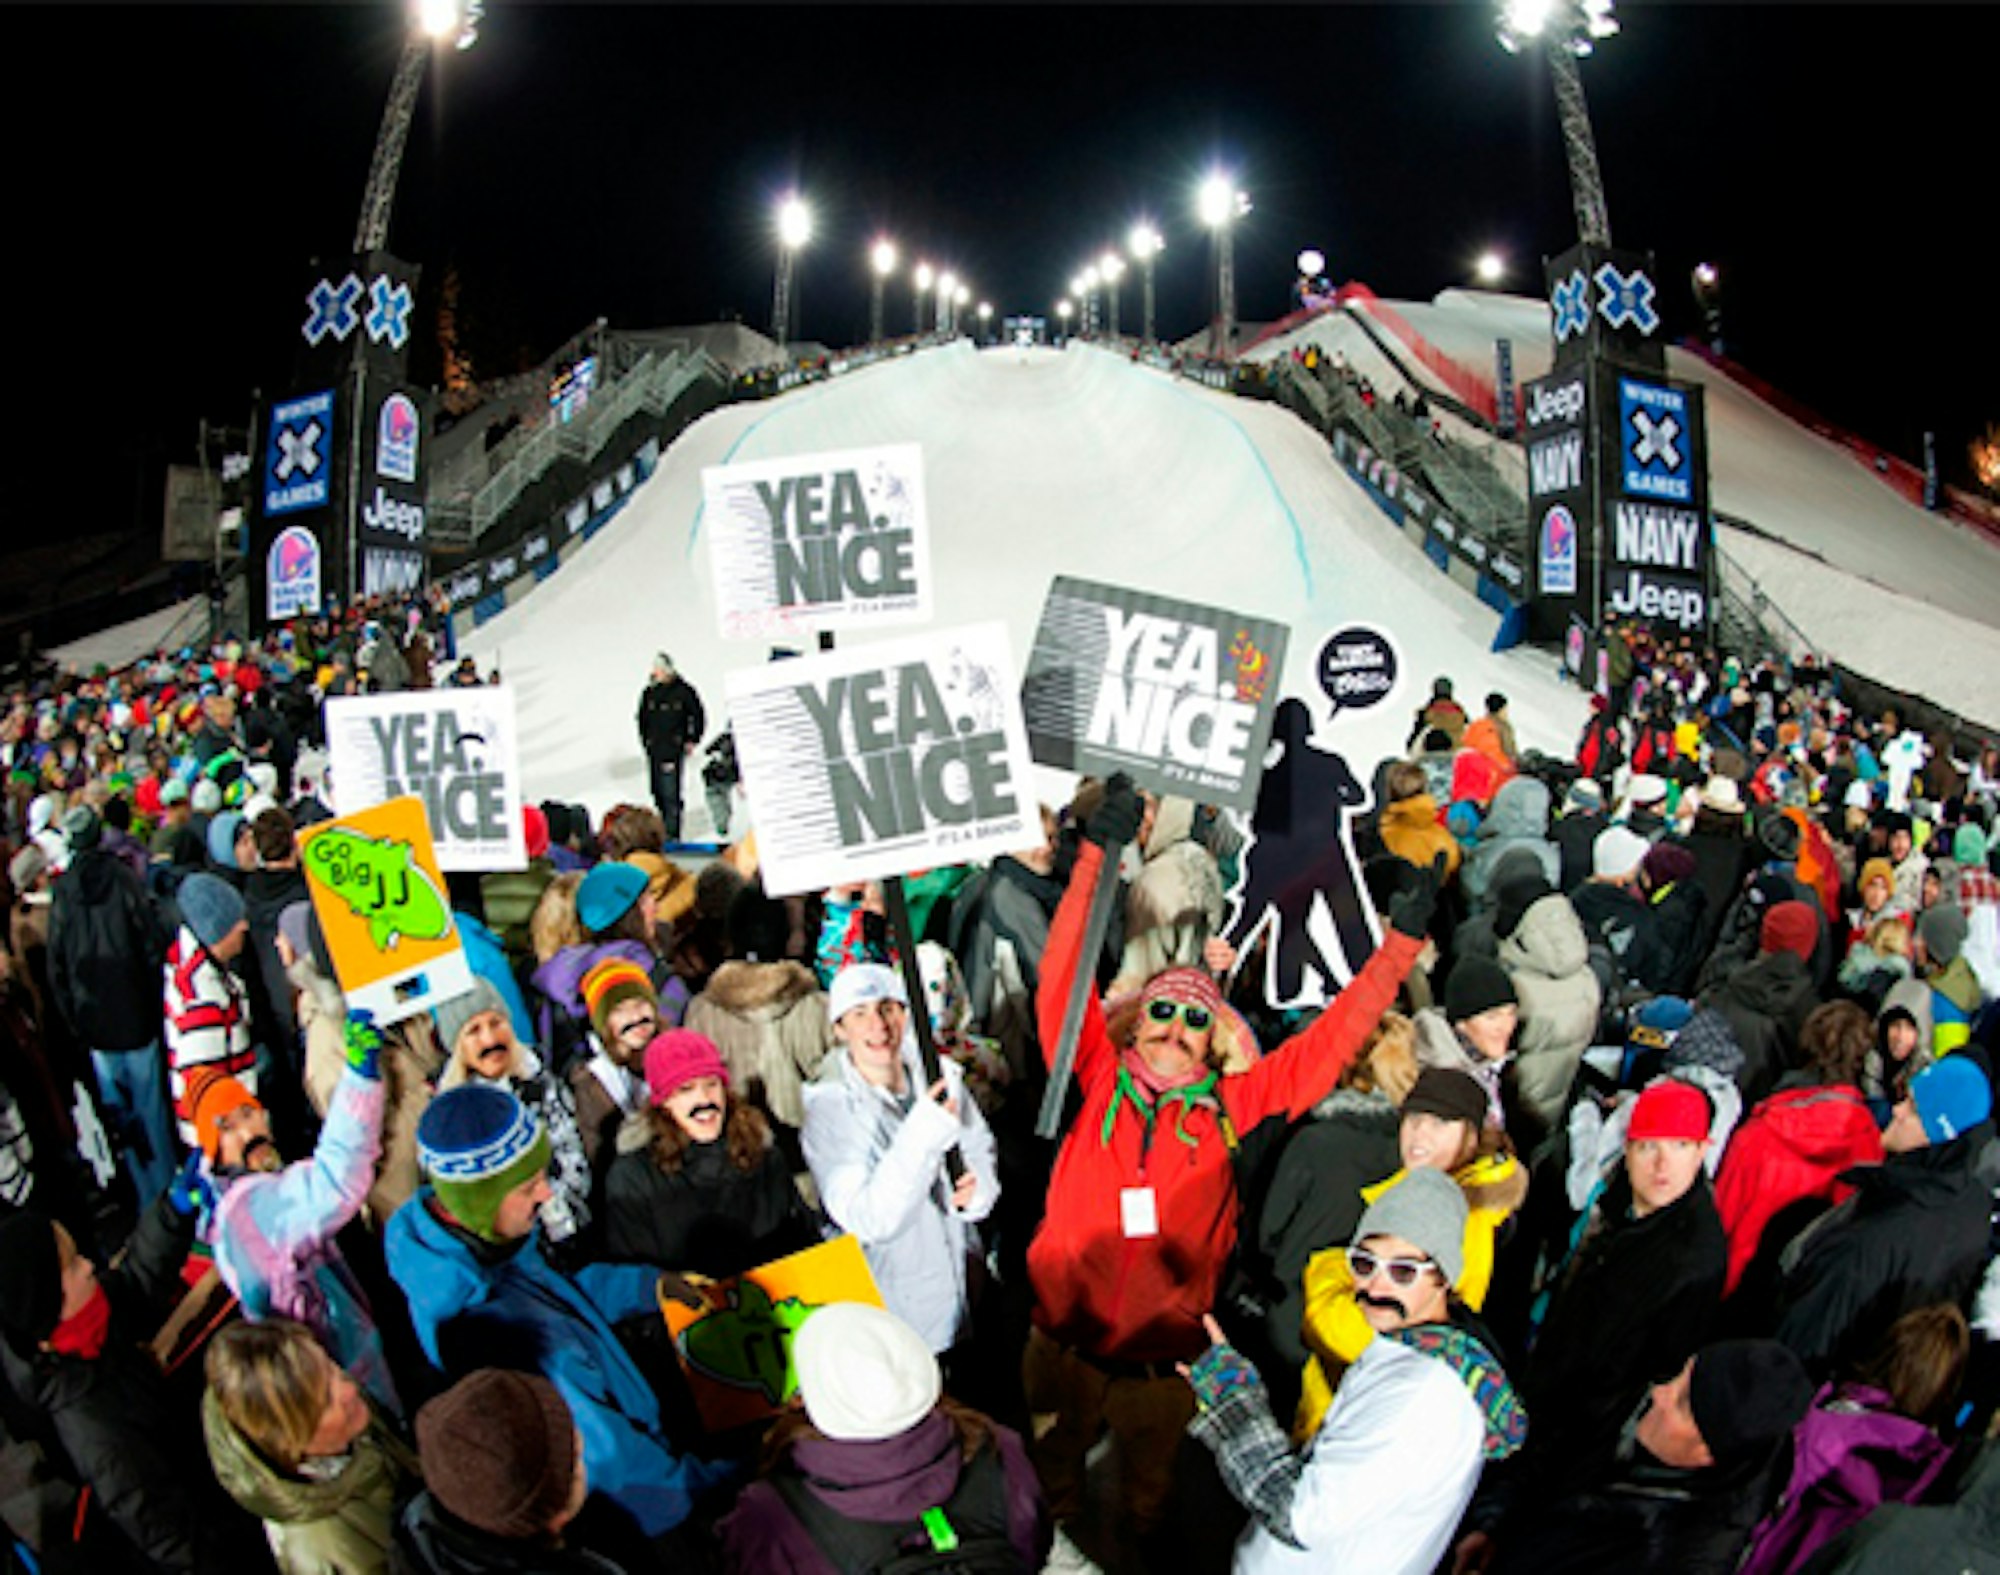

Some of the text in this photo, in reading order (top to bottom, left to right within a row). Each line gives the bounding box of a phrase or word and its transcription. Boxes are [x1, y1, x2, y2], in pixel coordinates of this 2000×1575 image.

[1527, 381, 1584, 425] Jeep
[1623, 385, 1684, 410] WINTER
[1530, 434, 1582, 494] NAVY
[1626, 471, 1688, 497] GAMES
[266, 480, 325, 511] GAMES
[364, 486, 424, 541] Jeep
[1615, 503, 1699, 569] NAVY
[774, 528, 918, 606] NICE
[1612, 570, 1703, 628] Jeep
[1085, 671, 1257, 778] NICE
[826, 730, 1019, 847] NICE
[369, 871, 409, 909] JJ
